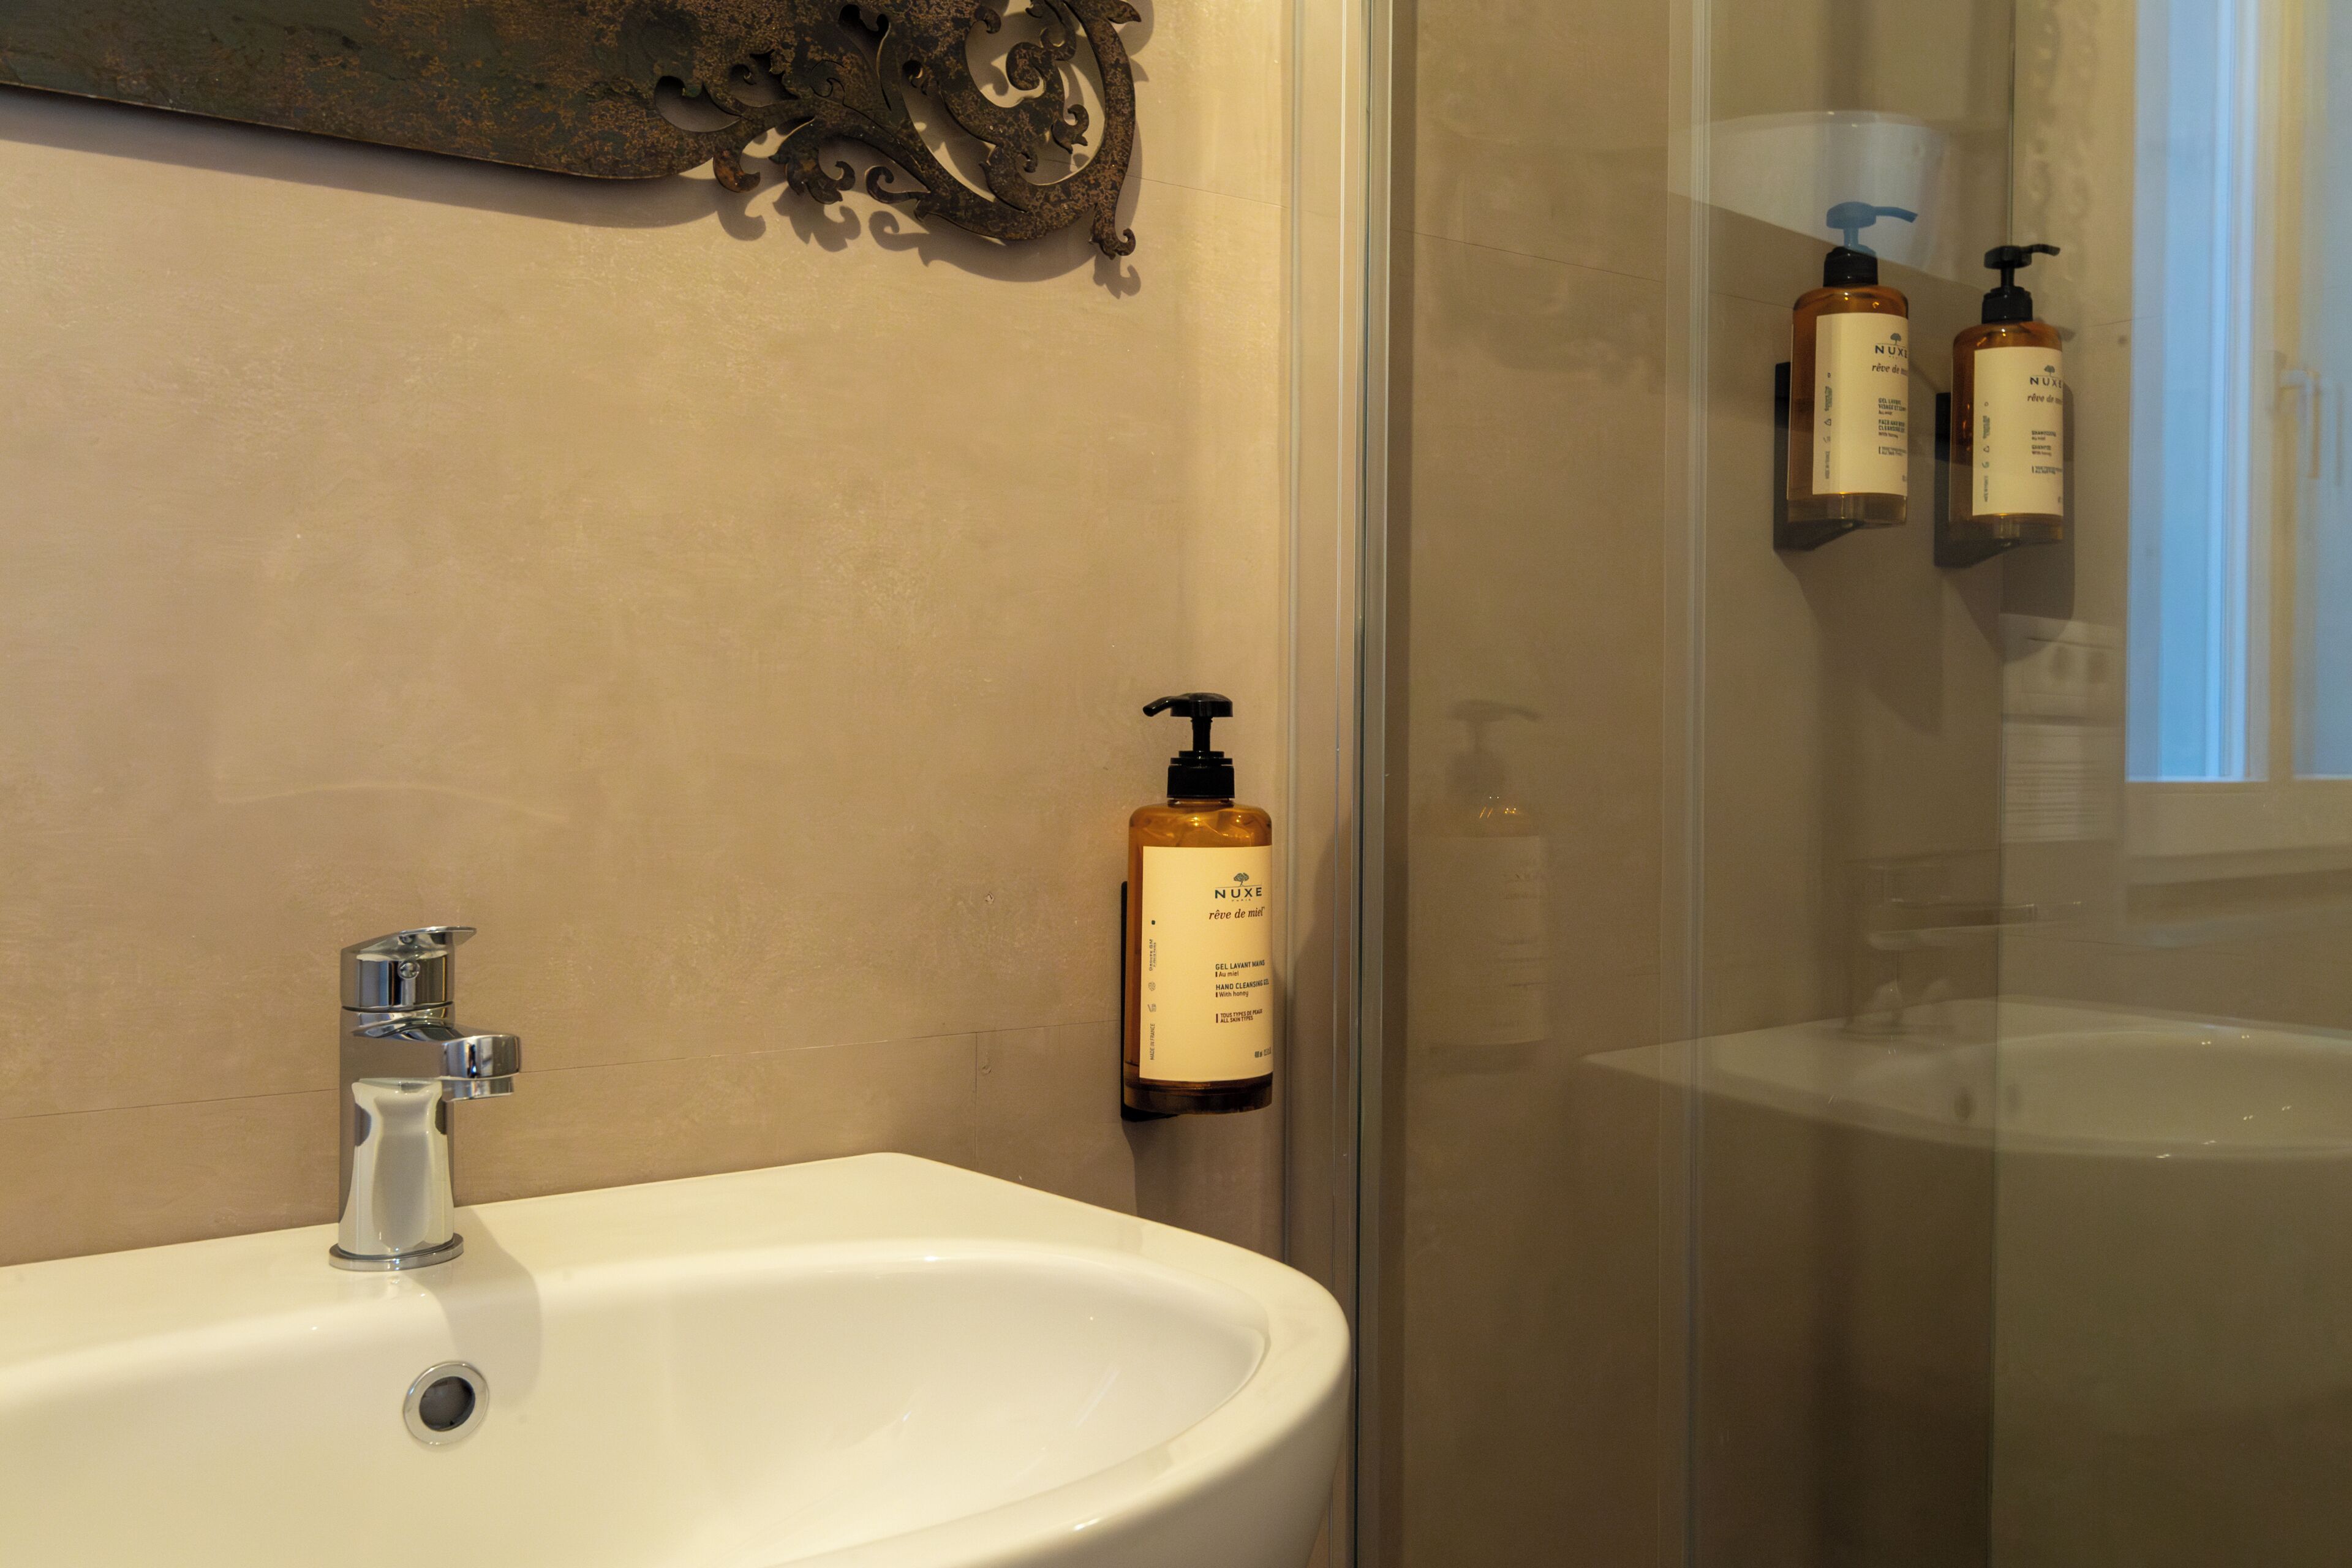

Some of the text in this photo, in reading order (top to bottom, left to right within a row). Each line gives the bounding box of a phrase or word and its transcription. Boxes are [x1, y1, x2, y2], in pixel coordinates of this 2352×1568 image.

[1215, 887, 1262, 899] NUXE
[1208, 910, 1232, 919] rêve
[1234, 908, 1246, 919] de
[1235, 979, 1263, 989] CLEANSING
